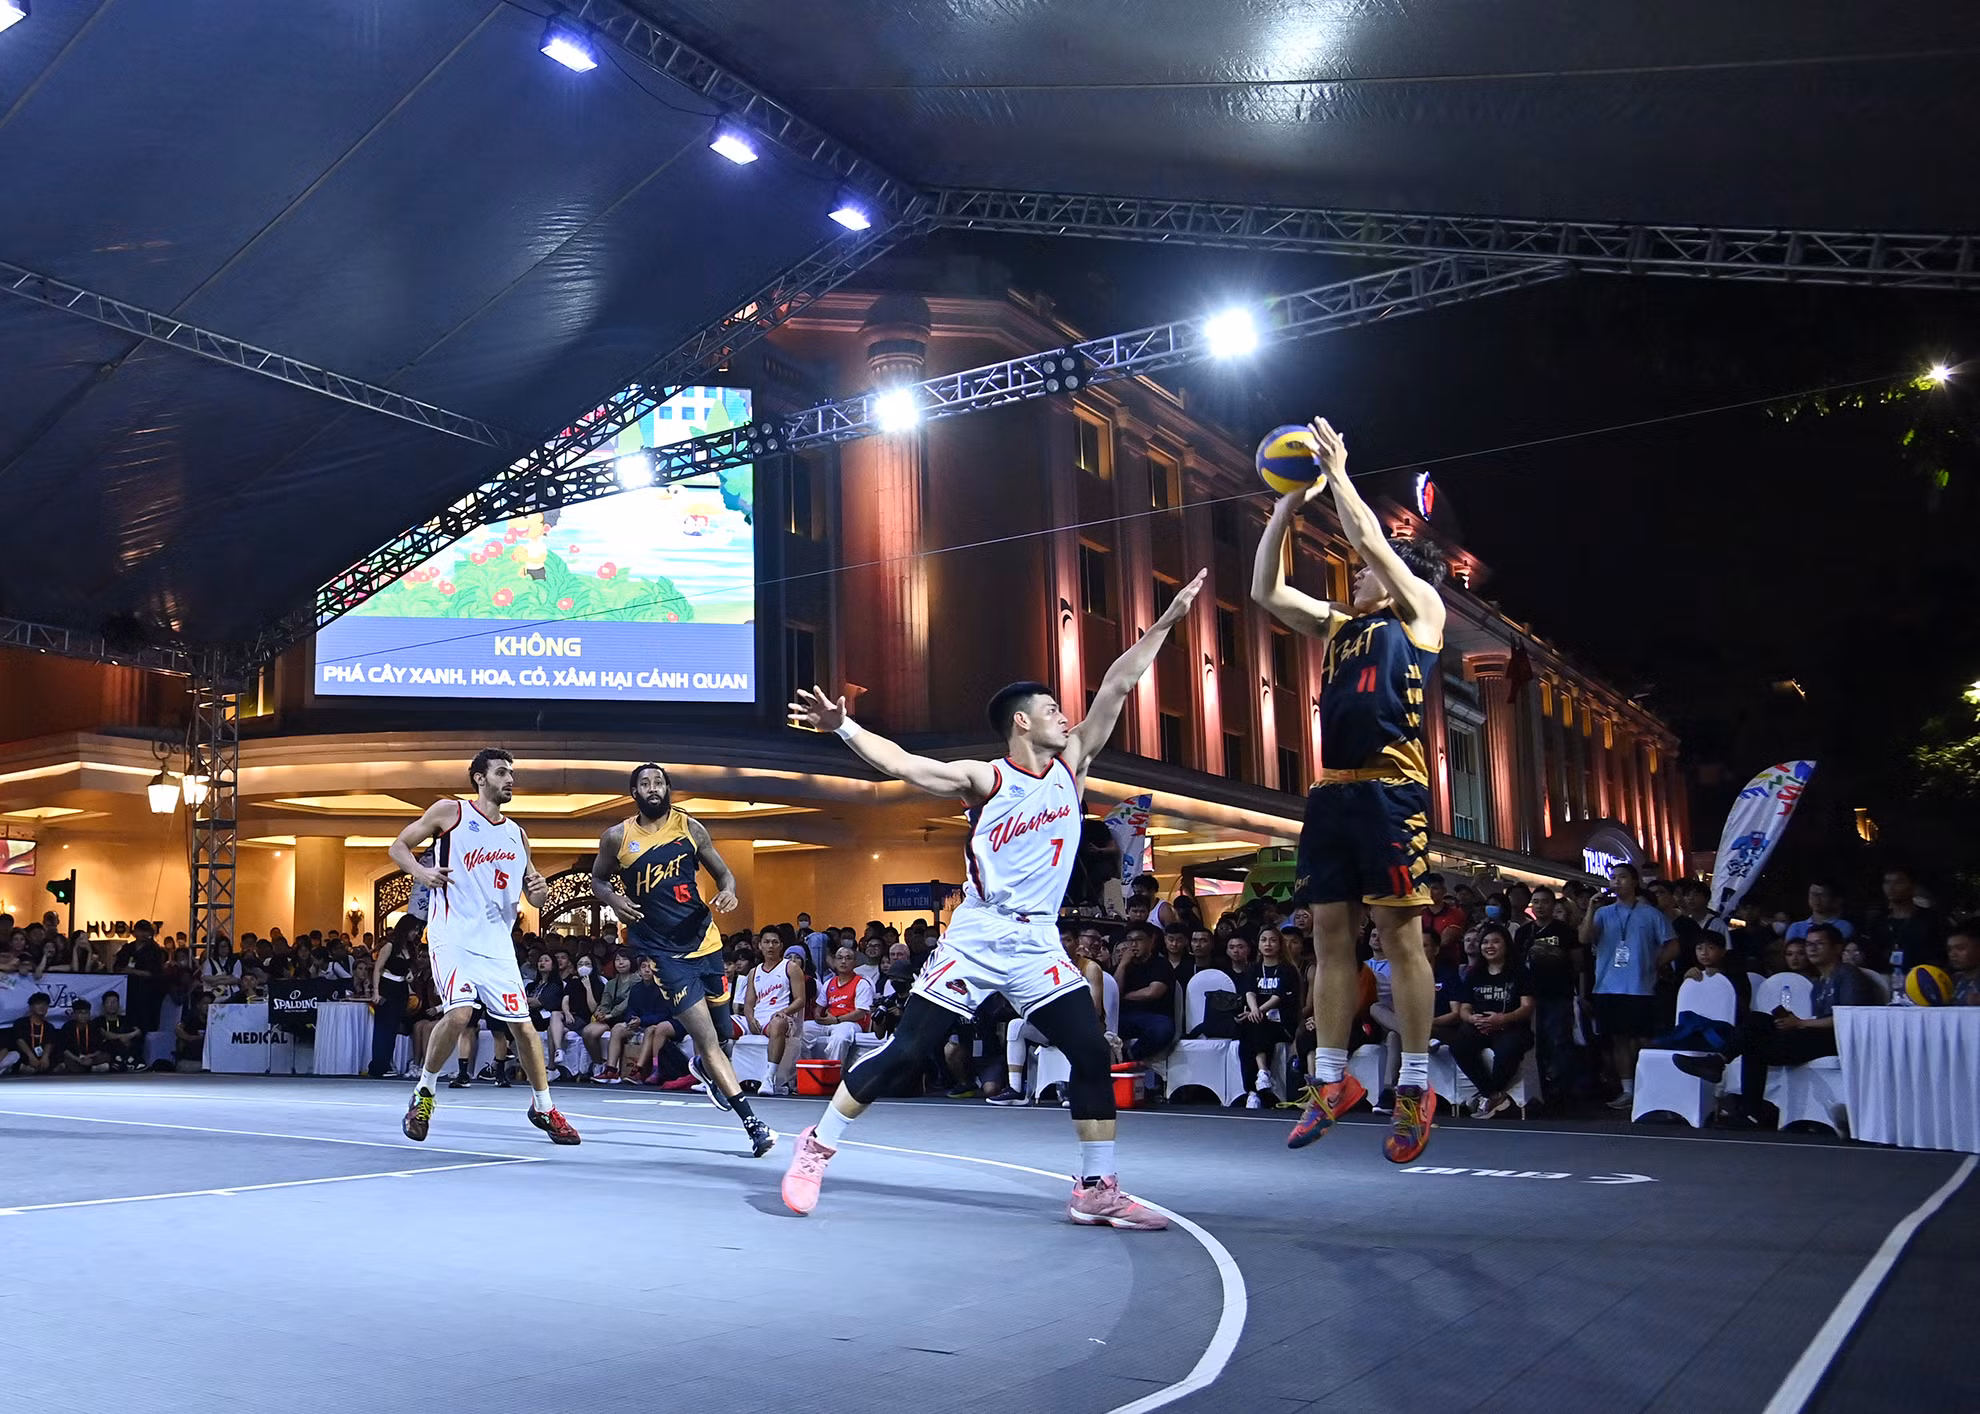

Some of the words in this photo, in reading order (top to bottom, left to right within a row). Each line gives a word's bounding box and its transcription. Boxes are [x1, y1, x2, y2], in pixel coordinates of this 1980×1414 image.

[494, 632, 583, 657] KHÔNG
[323, 662, 366, 683] PHÁ
[367, 663, 408, 683] CÂY
[409, 667, 467, 686] XANH,
[471, 668, 516, 687] HOA,
[519, 666, 550, 687] CỎ,
[553, 666, 597, 687] XÂM
[600, 671, 633, 691] HẠI
[636, 667, 689, 688] CẢNH
[692, 673, 748, 689] QUAN
[1357, 666, 1377, 693] 11
[989, 804, 1071, 853] Warriors
[1050, 838, 1064, 867] 7
[493, 868, 509, 890] 15
[673, 884, 692, 903] 15
[87, 921, 164, 938] HUBLT
[1043, 965, 1061, 986] 7
[273, 997, 318, 1010] SPALDING
[502, 993, 519, 1011] 15
[769, 996, 778, 1006] 5
[231, 1031, 288, 1045] MEDICAL
